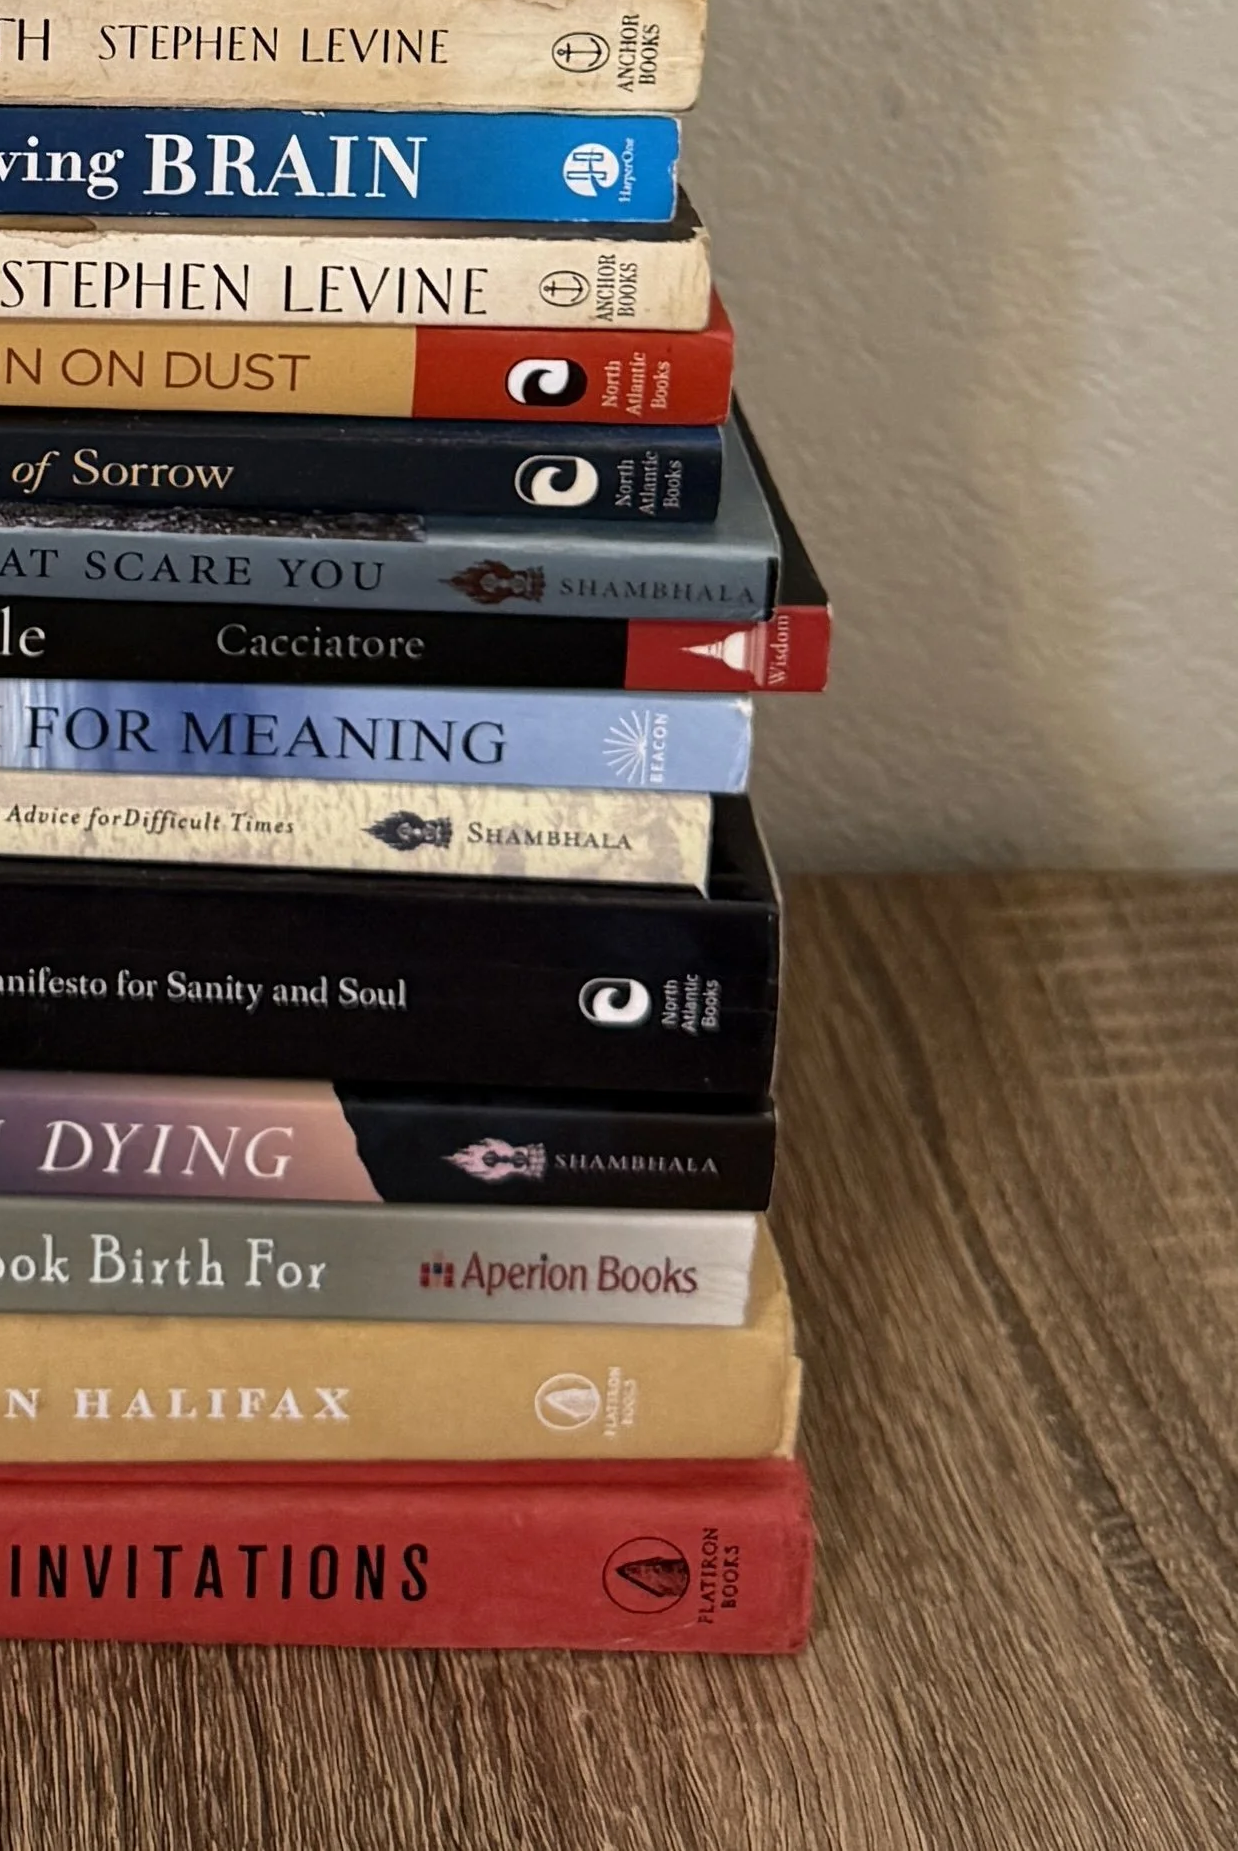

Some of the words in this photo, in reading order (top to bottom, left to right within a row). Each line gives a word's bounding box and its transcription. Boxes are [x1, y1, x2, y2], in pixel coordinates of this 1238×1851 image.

[98, 25, 279, 62] STEPHEN
[302, 28, 449, 64] LEVINE
[617, 14, 639, 94] ANCHOR
[641, 23, 660, 85] BOOKS
[144, 133, 427, 199] BRAIN
[602, 359, 621, 409] North
[625, 352, 646, 416] Atlantic
[650, 360, 668, 409] Books
[11, 452, 58, 487] of
[73, 449, 234, 489] Sorrow
[216, 624, 425, 659] Cacciatore
[768, 614, 789, 685] Wisdom
[649, 712, 666, 785] BEACON
[5, 804, 83, 826] Advice
[86, 806, 123, 835] for
[123, 808, 221, 835] Difficult
[230, 812, 294, 835] Times
[116, 969, 158, 999] for
[167, 972, 263, 1007] Sanity
[272, 976, 329, 1007] and
[338, 977, 408, 1010] Soul
[462, 1251, 588, 1297] Aperion
[598, 1254, 698, 1296] Books
[10, 1545, 429, 1602] INVITATIONS
[699, 1527, 718, 1623] FLATIRON
[720, 1544, 739, 1610] BOOKS
